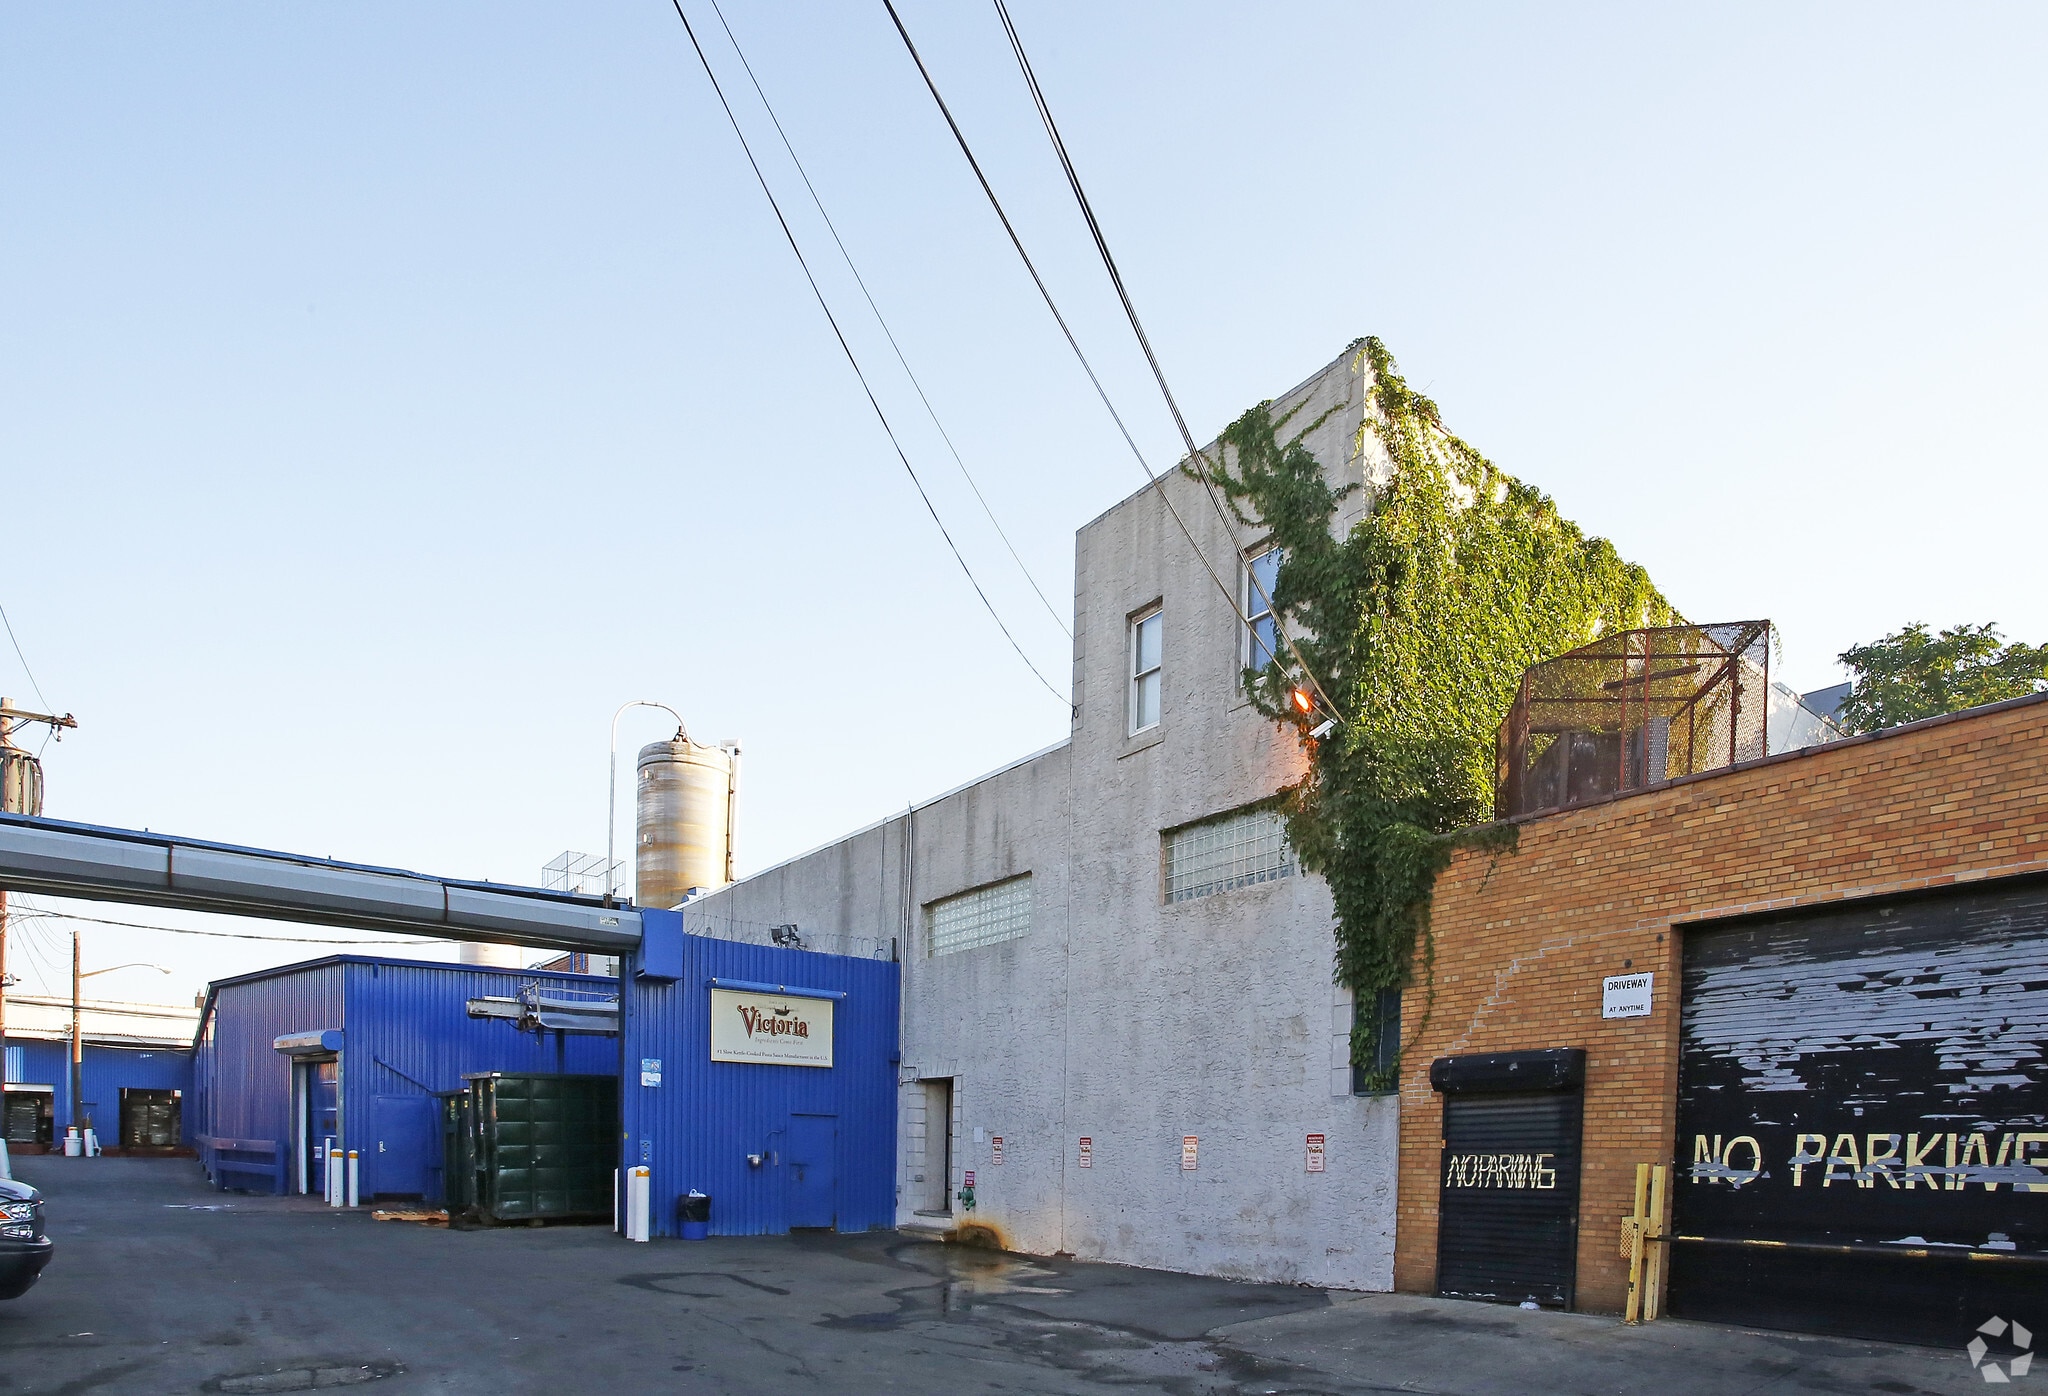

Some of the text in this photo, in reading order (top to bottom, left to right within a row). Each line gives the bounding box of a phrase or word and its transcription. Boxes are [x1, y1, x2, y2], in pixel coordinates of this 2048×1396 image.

[1608, 978, 1648, 991] DRIVEWAY
[1619, 1003, 1645, 1012] ANYTIME
[737, 1004, 809, 1040] Victoria
[1692, 1134, 1762, 1185] NO
